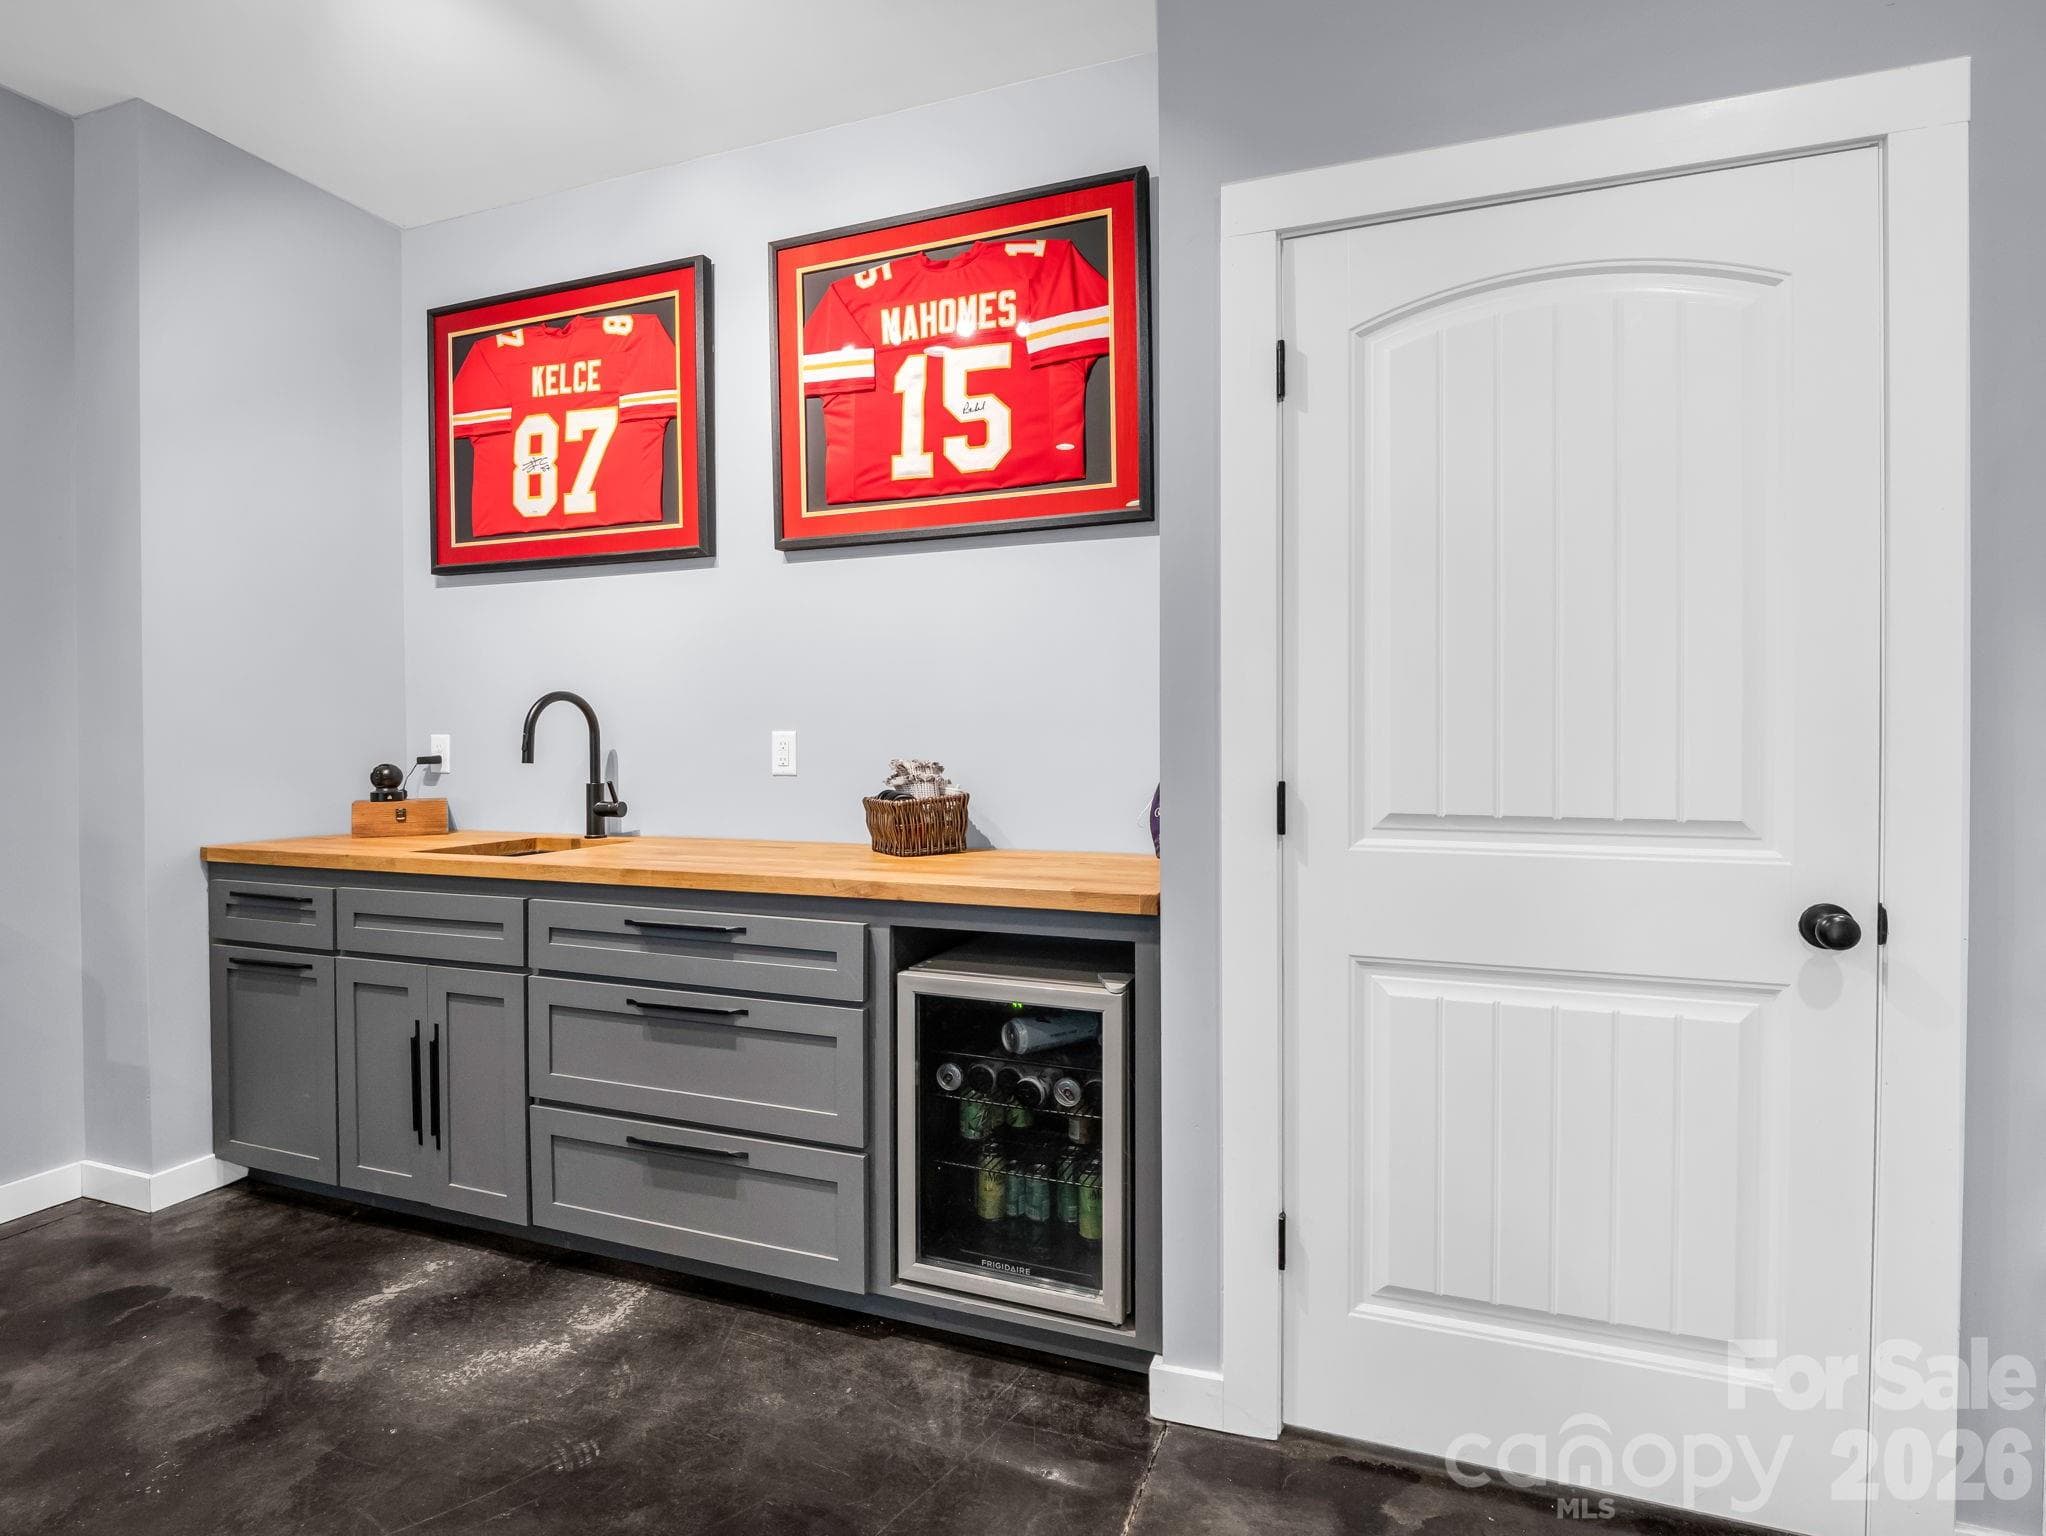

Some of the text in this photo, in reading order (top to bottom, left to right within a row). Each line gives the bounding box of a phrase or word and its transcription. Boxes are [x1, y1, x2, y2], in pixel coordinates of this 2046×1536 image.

[881, 290, 1016, 345] MAHOMES
[531, 359, 602, 398] KELCE
[891, 342, 1012, 481] 15
[513, 406, 619, 518] 87
[981, 1259, 1031, 1276] FRIGIDAIRE
